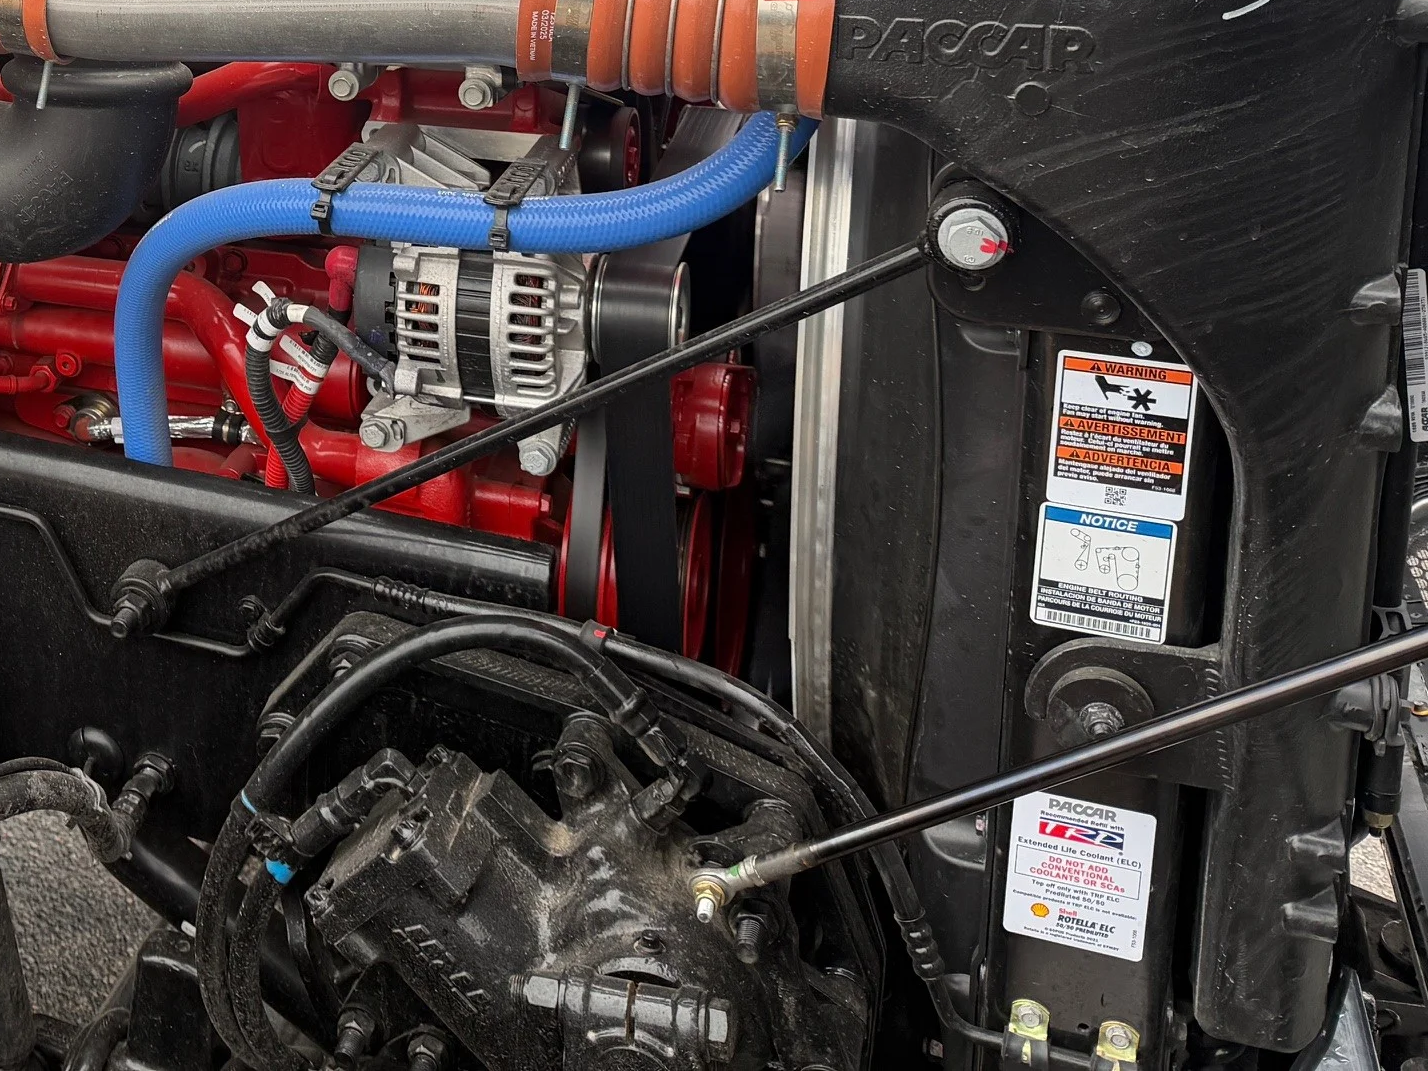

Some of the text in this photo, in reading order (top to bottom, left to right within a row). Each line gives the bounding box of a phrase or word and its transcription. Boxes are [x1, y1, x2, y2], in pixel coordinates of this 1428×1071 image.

[540, 10, 550, 40] 03/2025
[836, 15, 1095, 71] PACCAR
[1104, 364, 1166, 379] WARNING
[1107, 409, 1130, 417] engine
[1077, 419, 1181, 442] AVERTISSEMENT
[1134, 418, 1163, 428] warning.
[1060, 440, 1105, 450] soudainement
[1114, 442, 1140, 450] pourrait
[1123, 437, 1157, 446] ventilateur
[1058, 458, 1098, 469] Mantengase
[1099, 464, 1123, 473] alejado
[1137, 470, 1170, 479] ventilador
[1083, 450, 1170, 472] ADVERTENCIA
[1057, 470, 1077, 478] previo
[1092, 469, 1112, 477] puede
[1080, 513, 1137, 532] NOTICE
[1040, 587, 1085, 600] INSTALACION
[1097, 597, 1121, 606] BANDA
[1133, 603, 1160, 613] MOTOR
[1058, 582, 1142, 602] ENGINE BELT ROUTING
[1037, 594, 1070, 605] PARCOURS
[1090, 604, 1122, 615] COURROIE
[1134, 612, 1161, 622] MOTEUR
[1040, 810, 1088, 823] Recommended
[1048, 798, 1117, 822] PACCAR
[1018, 835, 1141, 868] Extended Life Coolant (ELC)
[1041, 861, 1114, 883] CONVENTIONAL
[1048, 855, 1108, 873] DO NOT ADD
[1029, 866, 1079, 882] COOLANTS
[1100, 882, 1124, 892] SCAs
[1045, 888, 1104, 906] Prediluted 50/50
[1058, 907, 1077, 916] Shell
[1058, 914, 1115, 934] ROTELLA ELC
